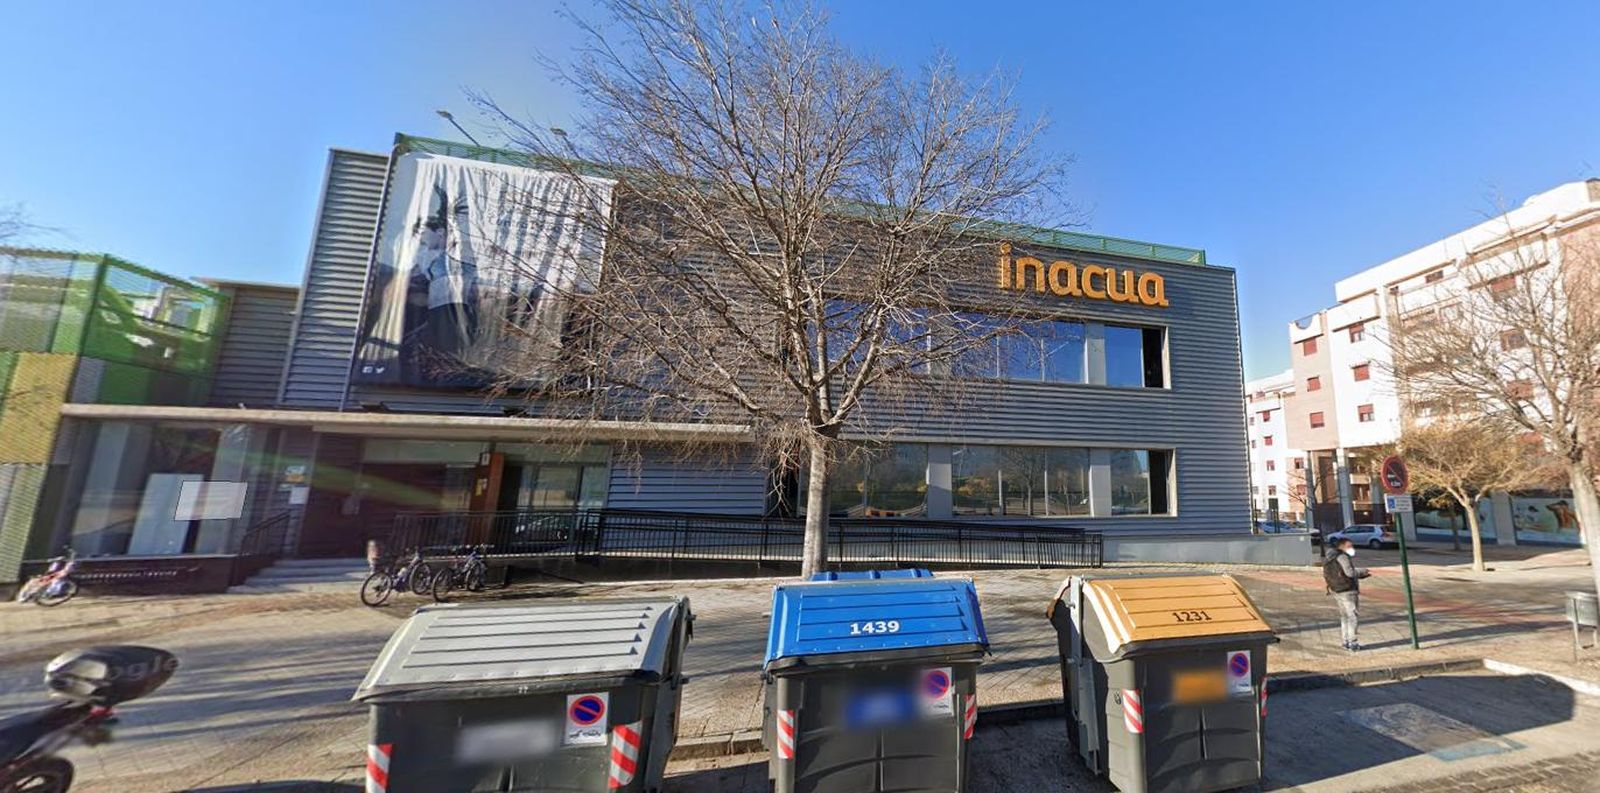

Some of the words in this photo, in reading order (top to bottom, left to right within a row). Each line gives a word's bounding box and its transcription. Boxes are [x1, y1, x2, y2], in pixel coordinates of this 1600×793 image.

[998, 241, 1169, 307] inacua
[1172, 610, 1212, 622] 1231
[850, 620, 900, 635] 1439
